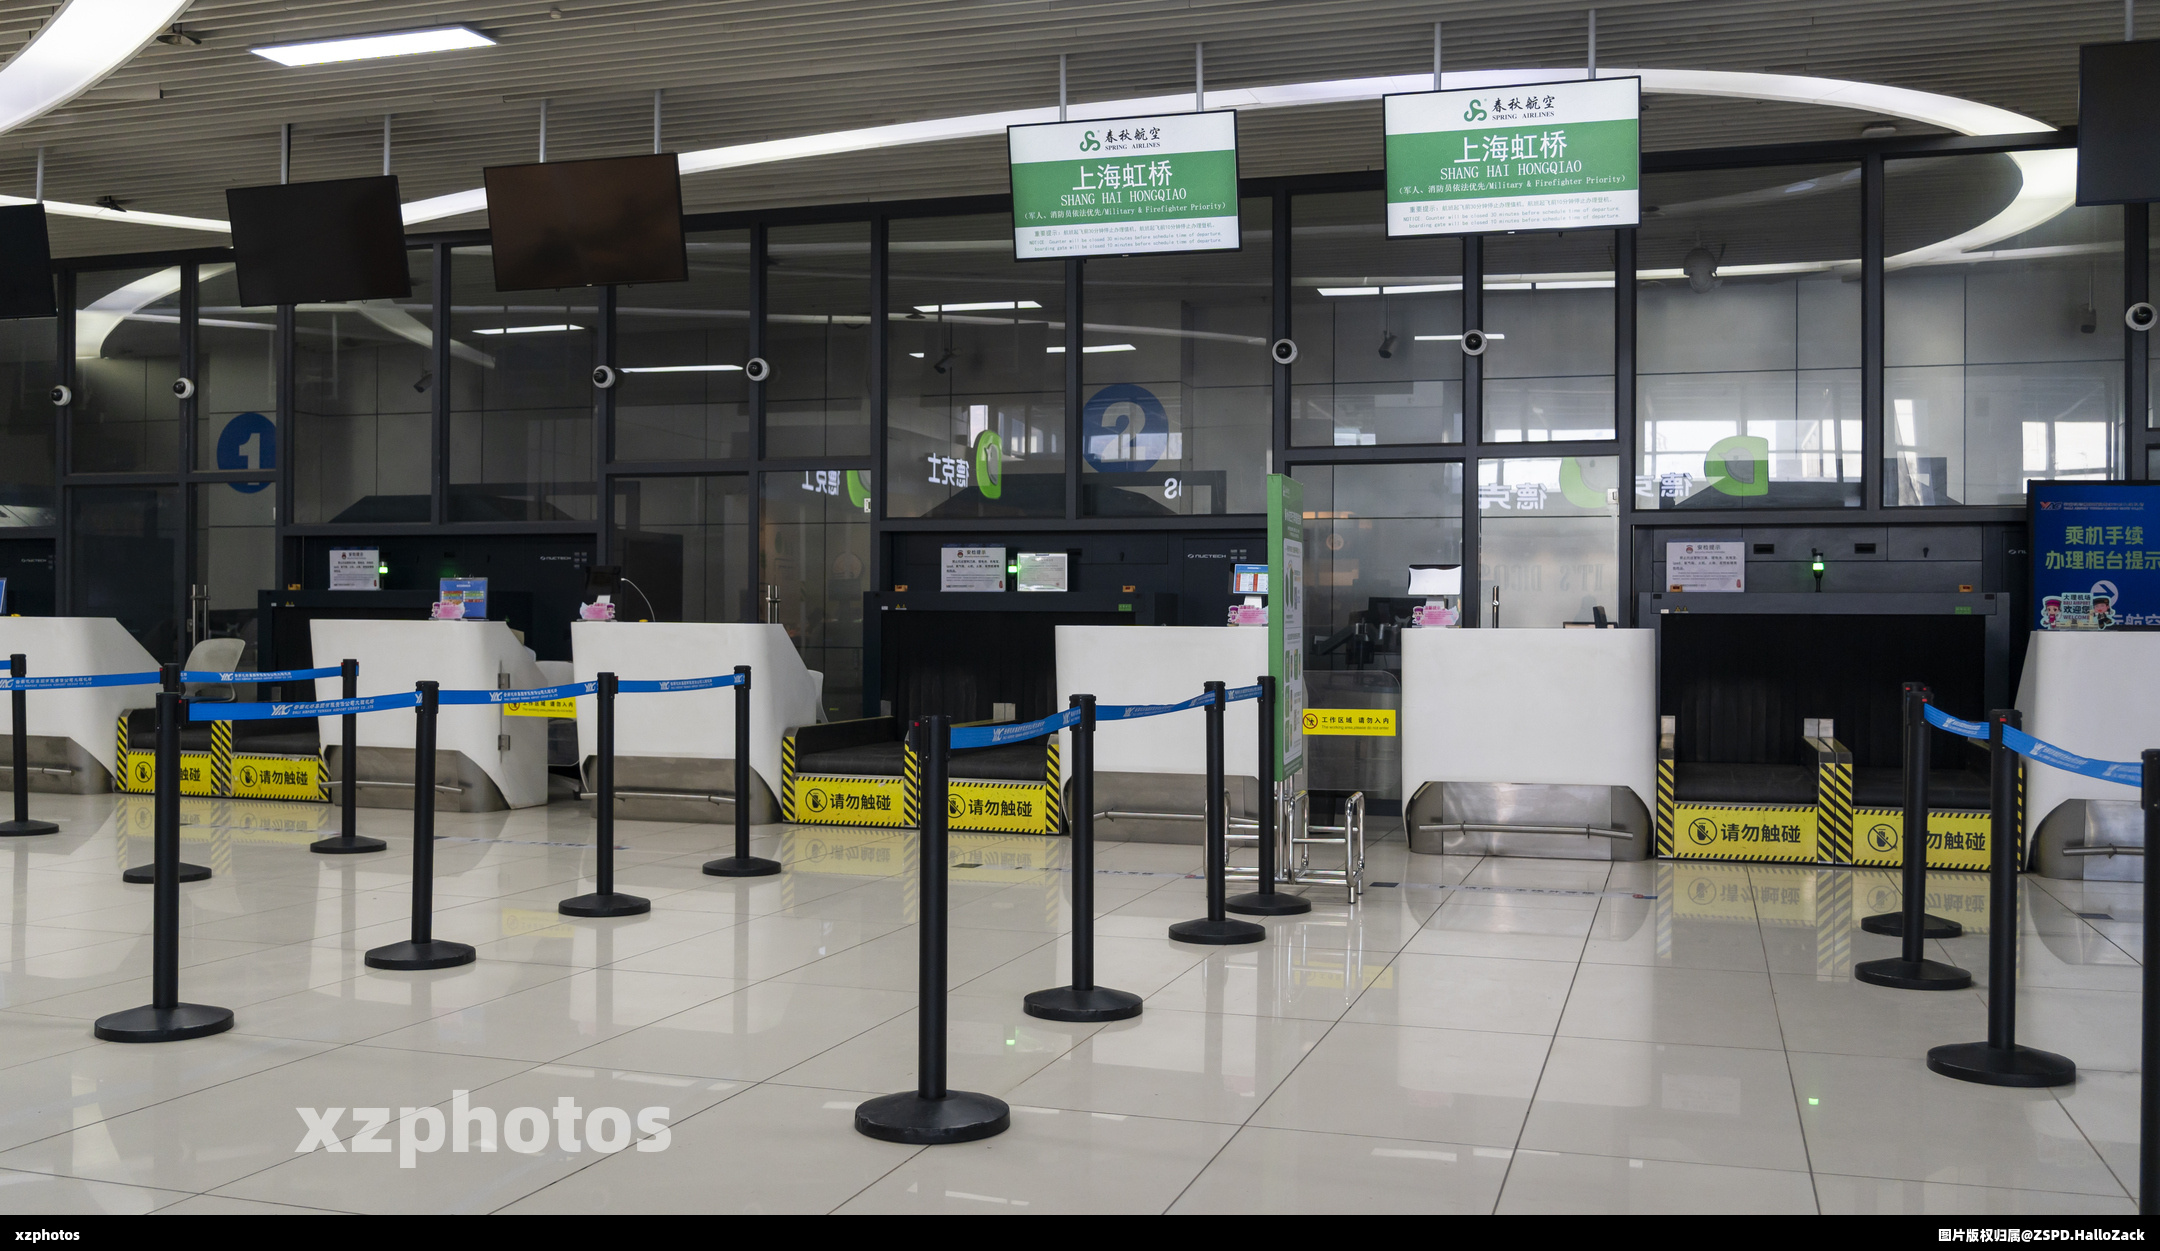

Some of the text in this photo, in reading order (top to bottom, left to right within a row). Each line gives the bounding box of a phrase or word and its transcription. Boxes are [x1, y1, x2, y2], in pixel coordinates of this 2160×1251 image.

[1491, 95, 1555, 113] 春秋航空
[1491, 111, 1555, 121] SPRING AIRLINES
[1105, 127, 1161, 143] 春秋航空
[1453, 130, 1568, 164] 上海虹桥
[1072, 160, 1173, 191] 上海虹桥
[1440, 160, 1582, 180] SHANG HAI HONGQIAO
[1526, 180, 1532, 188] &
[1535, 177, 1583, 188] Firefighter
[1061, 188, 1187, 207] SHANG HAI HONGQIAO
[1146, 205, 1187, 214] Firefighter
[1101, 401, 1146, 463] 2
[239, 433, 260, 486] 1
[2065, 525, 2144, 545] 乘机手续
[2045, 550, 2160, 570] 办理柜台提示
[2063, 605, 2090, 614] 欢迎您
[1321, 716, 1352, 724] 工作区域
[259, 770, 308, 786] 请勿触碰
[830, 793, 892, 811] 请勿触碰
[968, 798, 1033, 817] 请勿触碰
[1720, 823, 1801, 844] 请勿触碰
